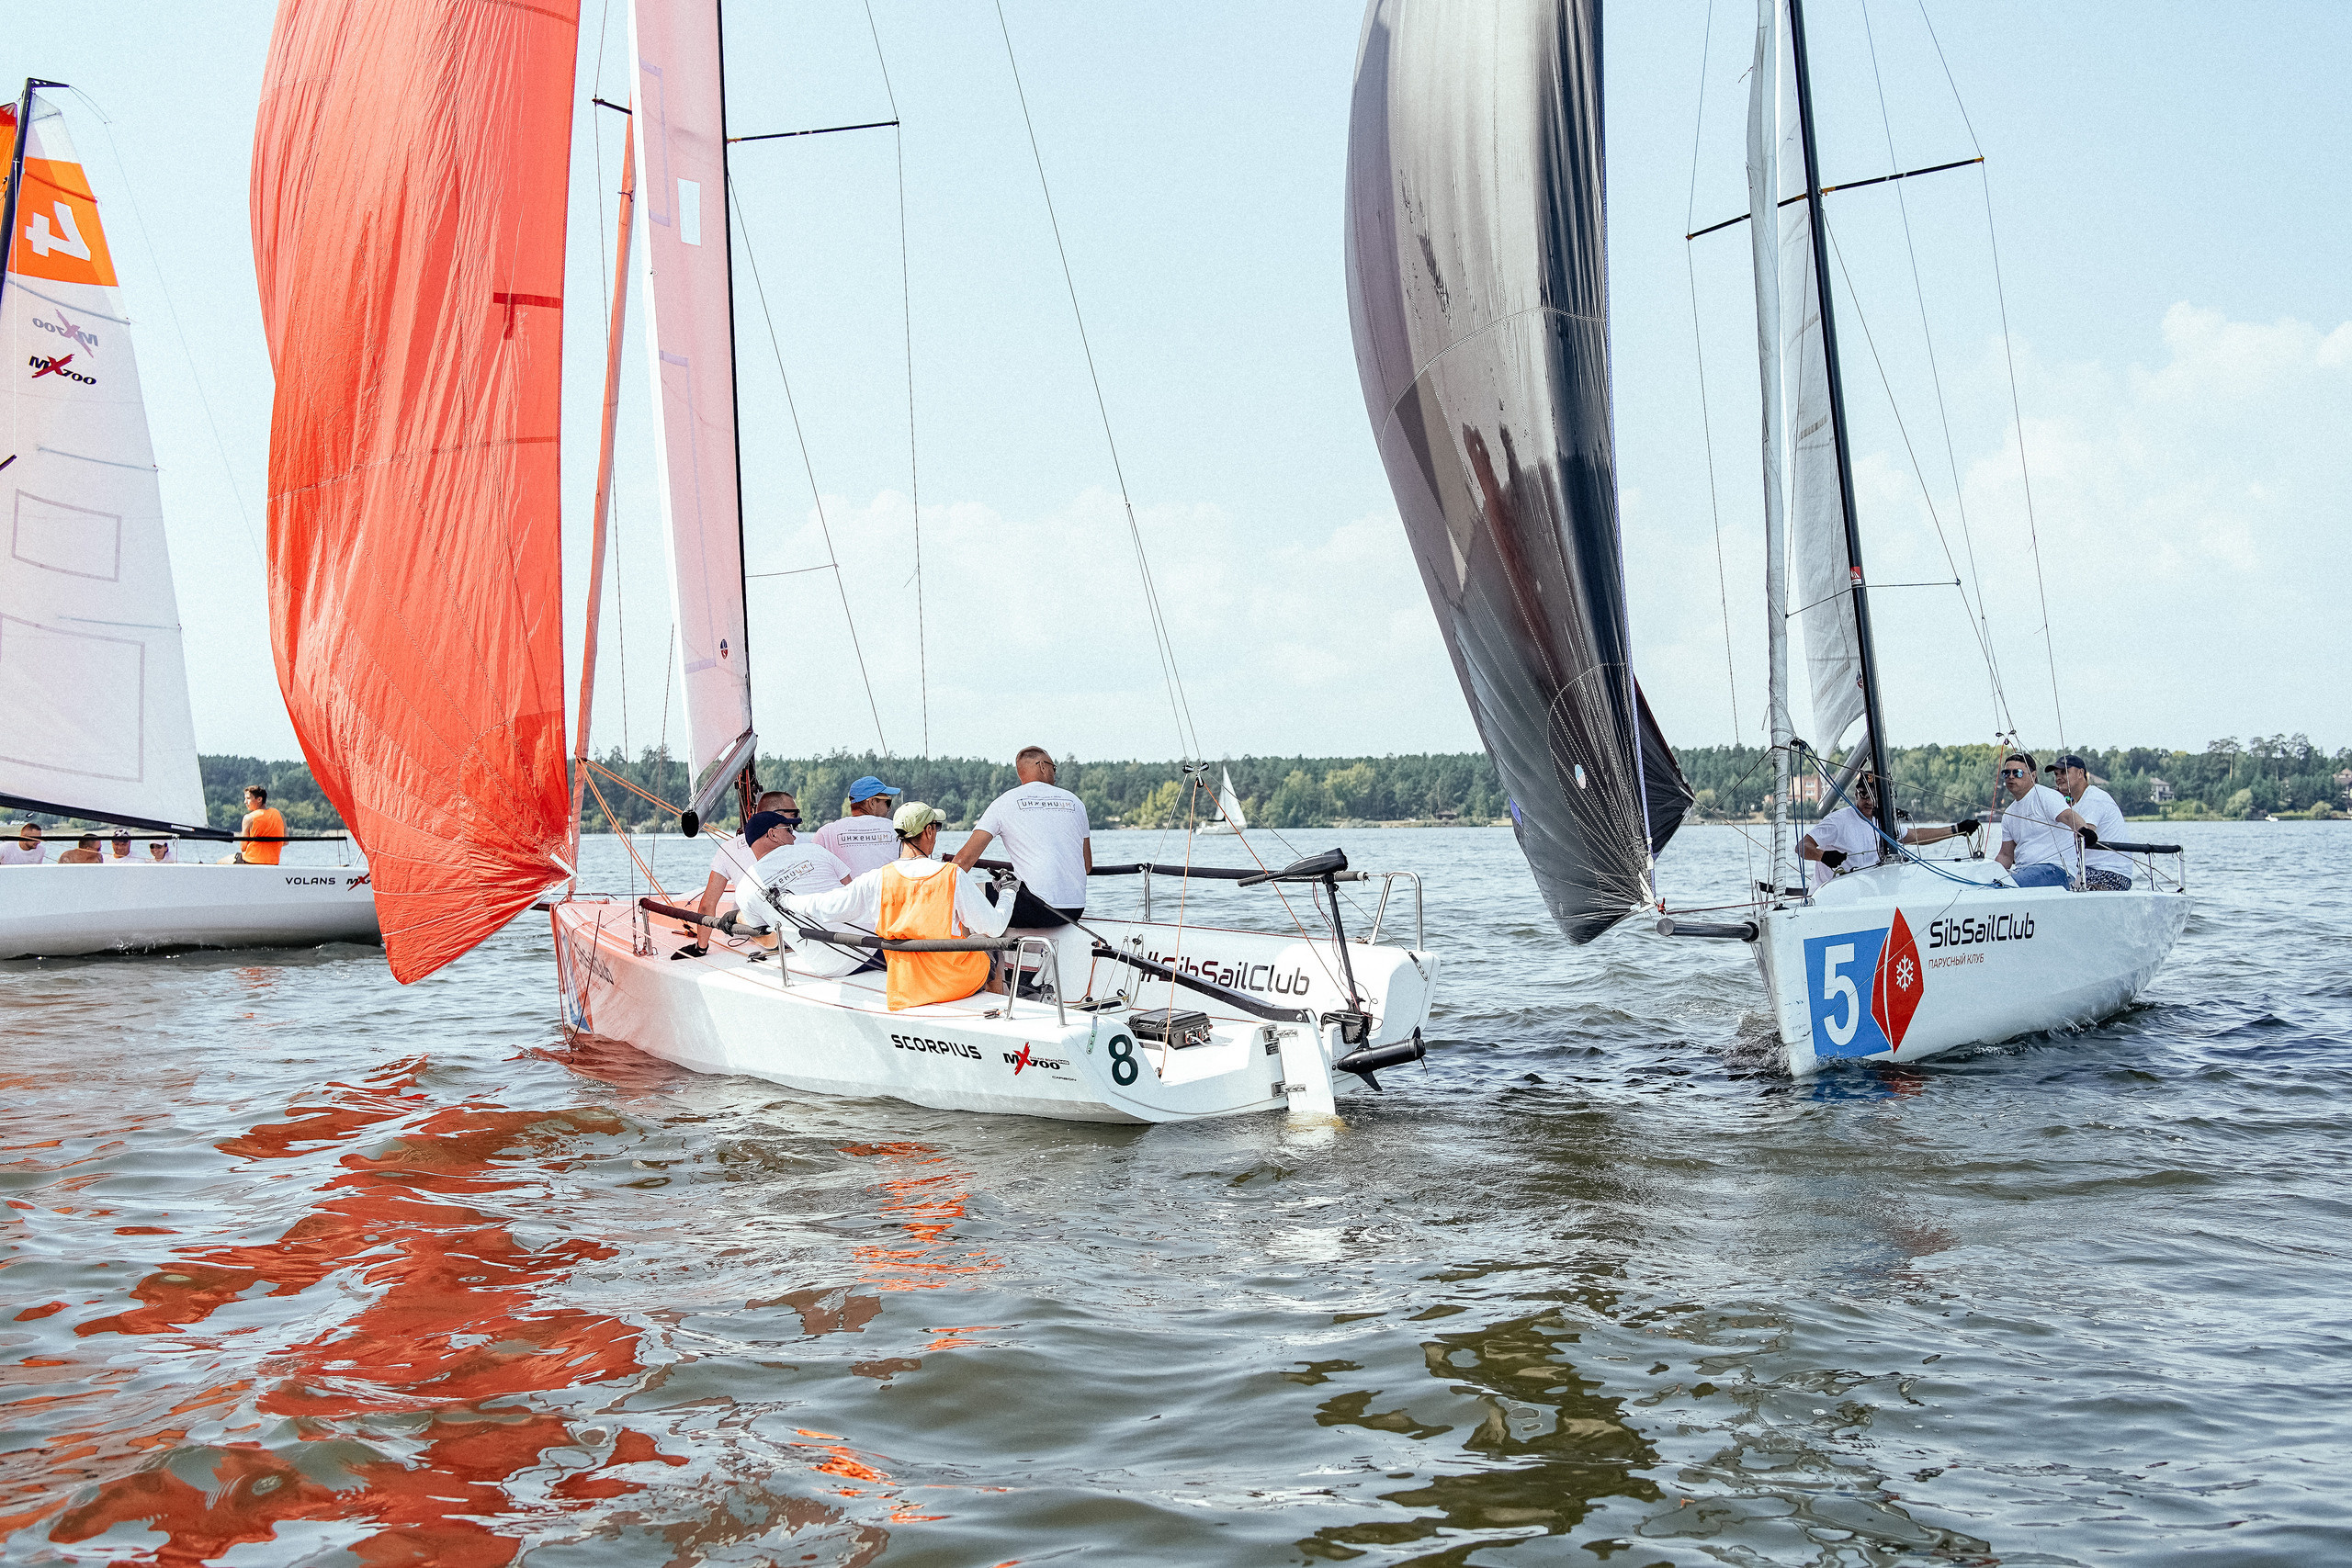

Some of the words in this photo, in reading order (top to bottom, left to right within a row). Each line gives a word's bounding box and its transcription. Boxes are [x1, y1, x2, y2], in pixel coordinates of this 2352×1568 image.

[28, 354, 97, 386] MX700
[1929, 912, 2035, 949] SibSailClub
[1928, 953, 1966, 969] ПАРУСНЫЙ
[1967, 953, 1984, 964] КЛУБ
[1824, 942, 1860, 1046] 5
[890, 1033, 982, 1060] SCORPIUS
[1002, 1041, 1061, 1077] MX700
[1108, 1033, 1139, 1087] 8
